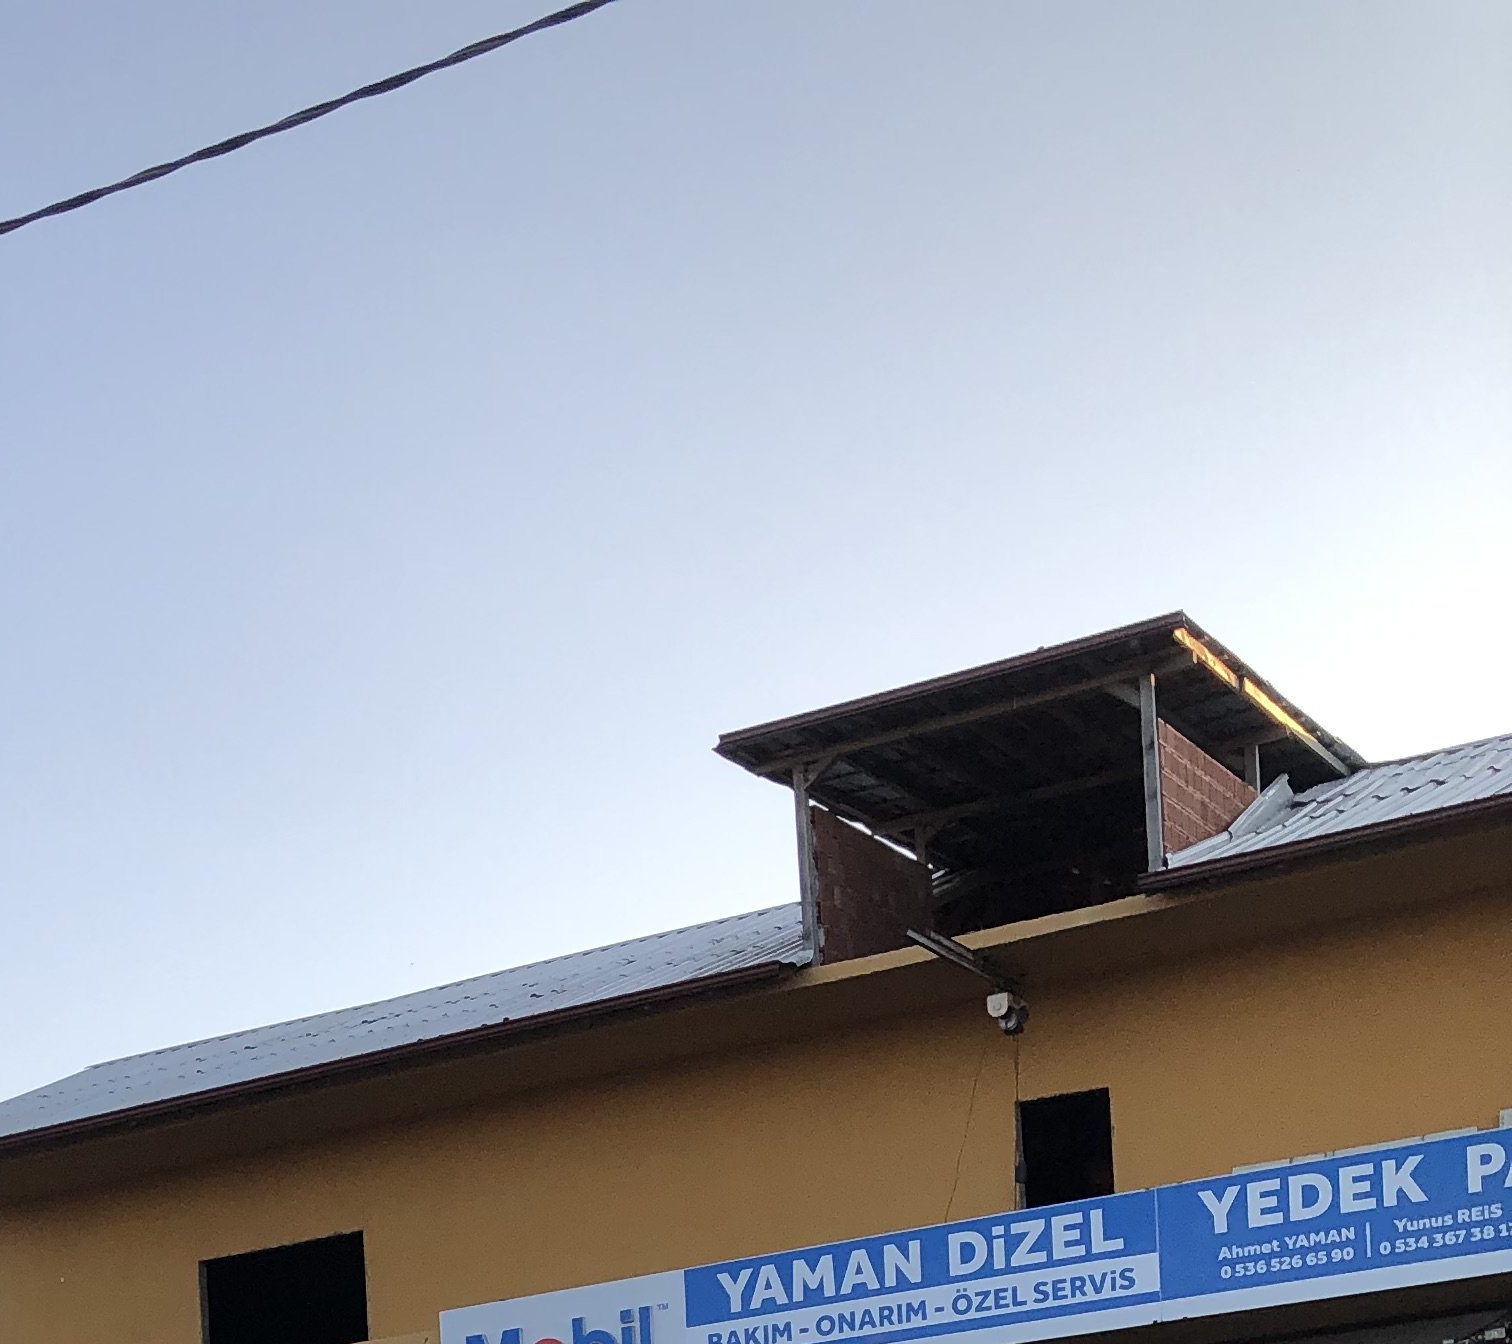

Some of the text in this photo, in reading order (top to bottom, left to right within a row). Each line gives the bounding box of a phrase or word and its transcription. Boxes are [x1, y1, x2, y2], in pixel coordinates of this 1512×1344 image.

[1197, 1142, 1512, 1235] YEDEK P
[1380, 1241, 1390, 1255] 0
[1394, 1233, 1430, 1253] 534
[1433, 1230, 1465, 1248] 367
[1470, 1225, 1496, 1242] 38
[1393, 1213, 1454, 1233] Yunus
[1218, 1227, 1356, 1261] Ahmet YAMAN
[716, 1239, 923, 1314] YAMAN
[1220, 1246, 1355, 1280] 0 536 526 65 90
[815, 1300, 928, 1338] ONARIM
[951, 1288, 1026, 1317] ÖZEL
